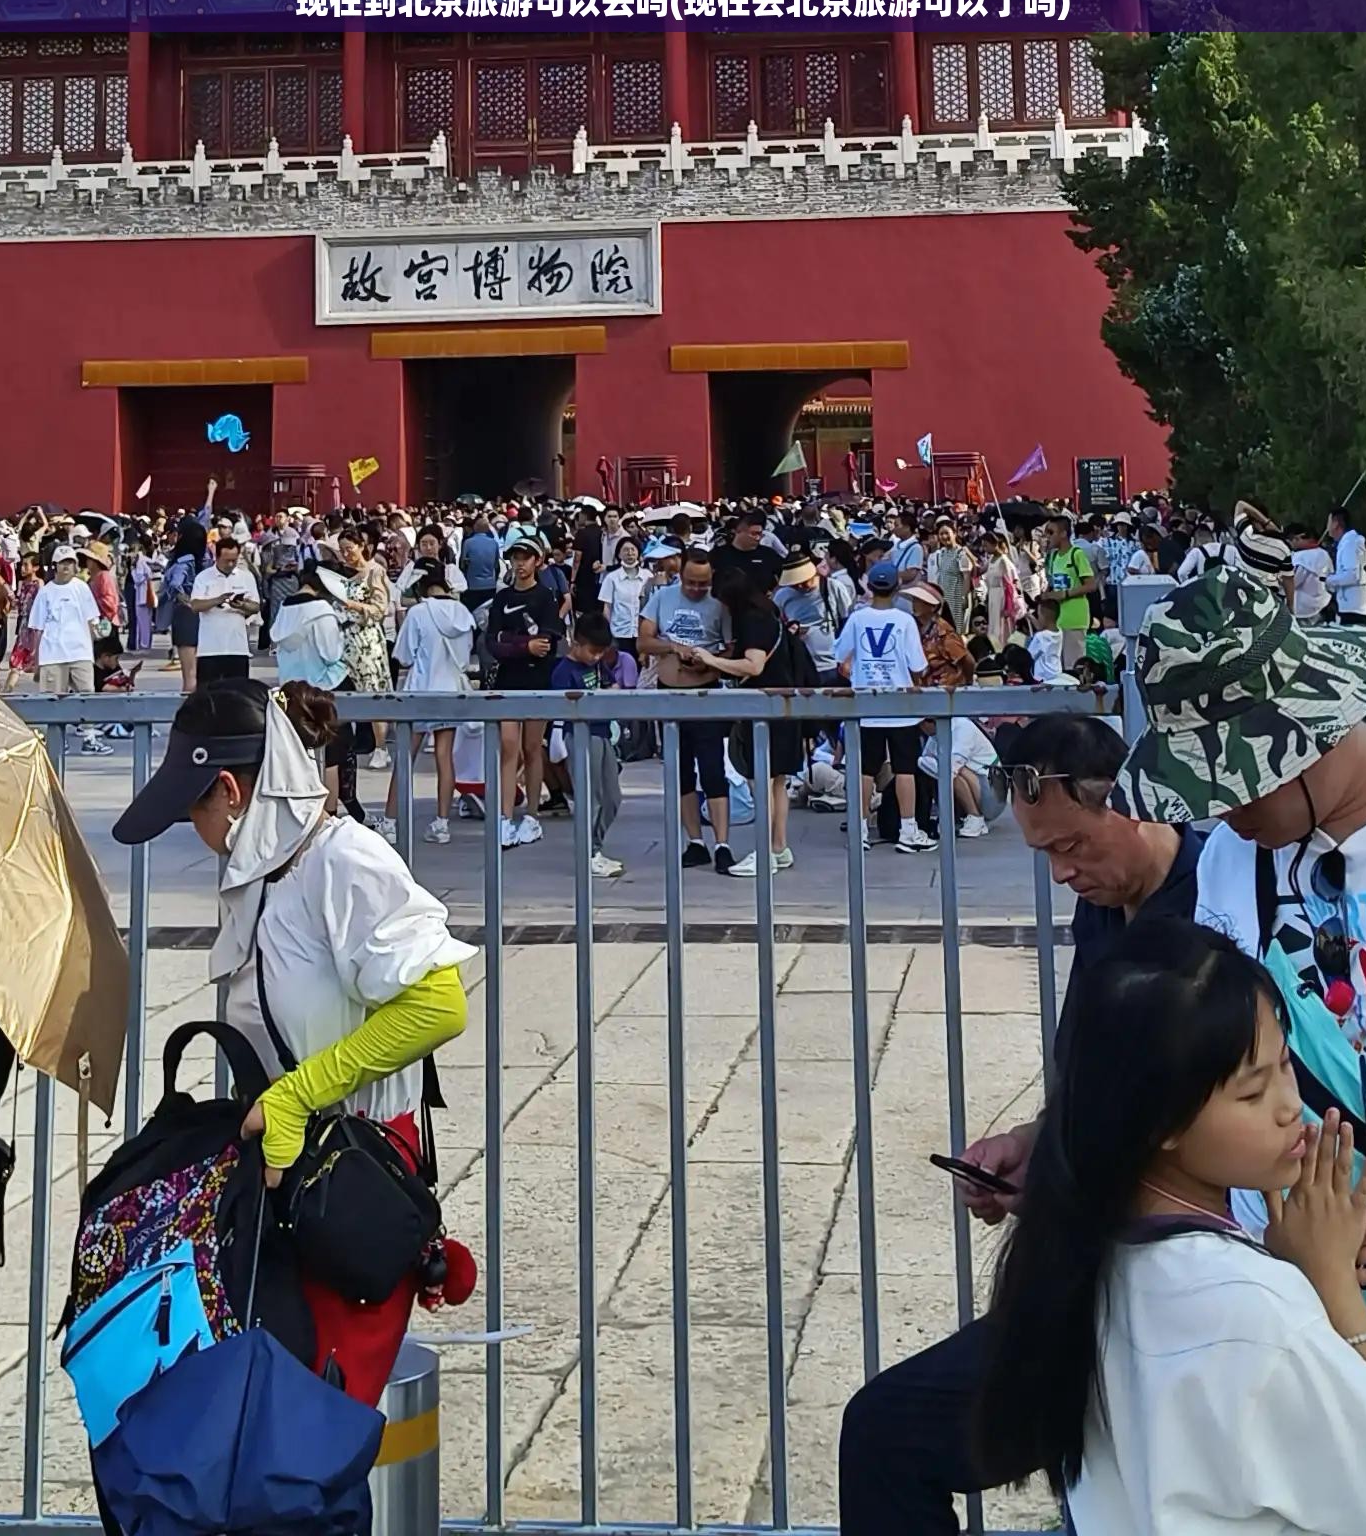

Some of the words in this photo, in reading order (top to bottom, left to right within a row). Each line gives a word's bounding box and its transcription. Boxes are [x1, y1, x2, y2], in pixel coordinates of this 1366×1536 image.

[341, 244, 634, 302] 故宫博物院
